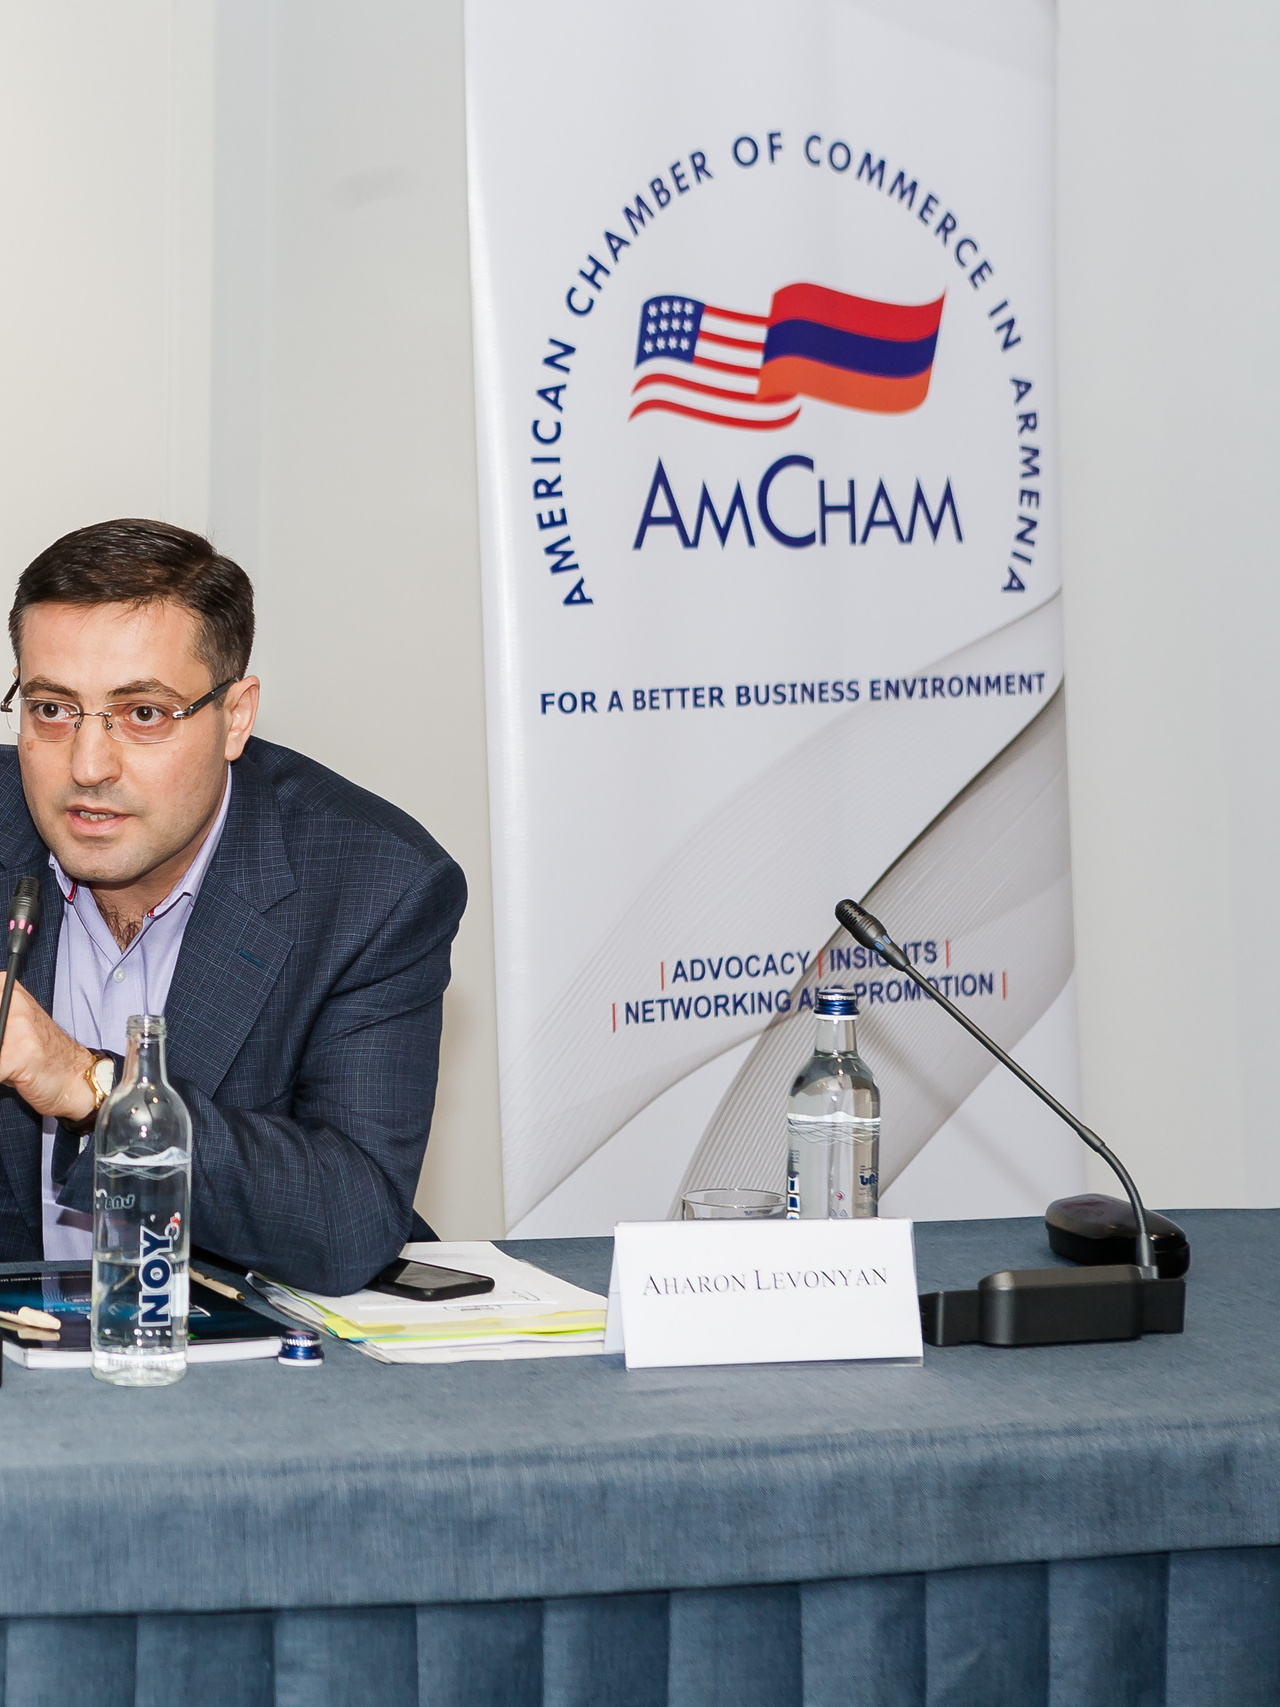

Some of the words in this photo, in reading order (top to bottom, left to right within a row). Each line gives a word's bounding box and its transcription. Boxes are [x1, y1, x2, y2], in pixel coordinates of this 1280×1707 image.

[732, 132, 783, 168] OF
[565, 150, 714, 317] CHAMBER
[804, 134, 993, 291] COMMERCE
[987, 298, 1022, 352] IN
[531, 338, 594, 606] AMERICAN
[1001, 377, 1041, 593] ARMENIA
[540, 691, 598, 715] FOR
[607, 691, 624, 712] A
[632, 686, 726, 711] BETTER
[736, 681, 861, 707] BUSINESS
[870, 672, 1047, 701] ENVIRONMENT
[672, 951, 810, 984] ADVOCACY
[829, 940, 938, 972] INSITS
[624, 988, 792, 1025] NETWORKING
[854, 972, 993, 1005] PROMOTION
[139, 1225, 172, 1326] NOY
[642, 1274, 748, 1296] AHARON
[753, 1267, 889, 1291] LEVONYAN
